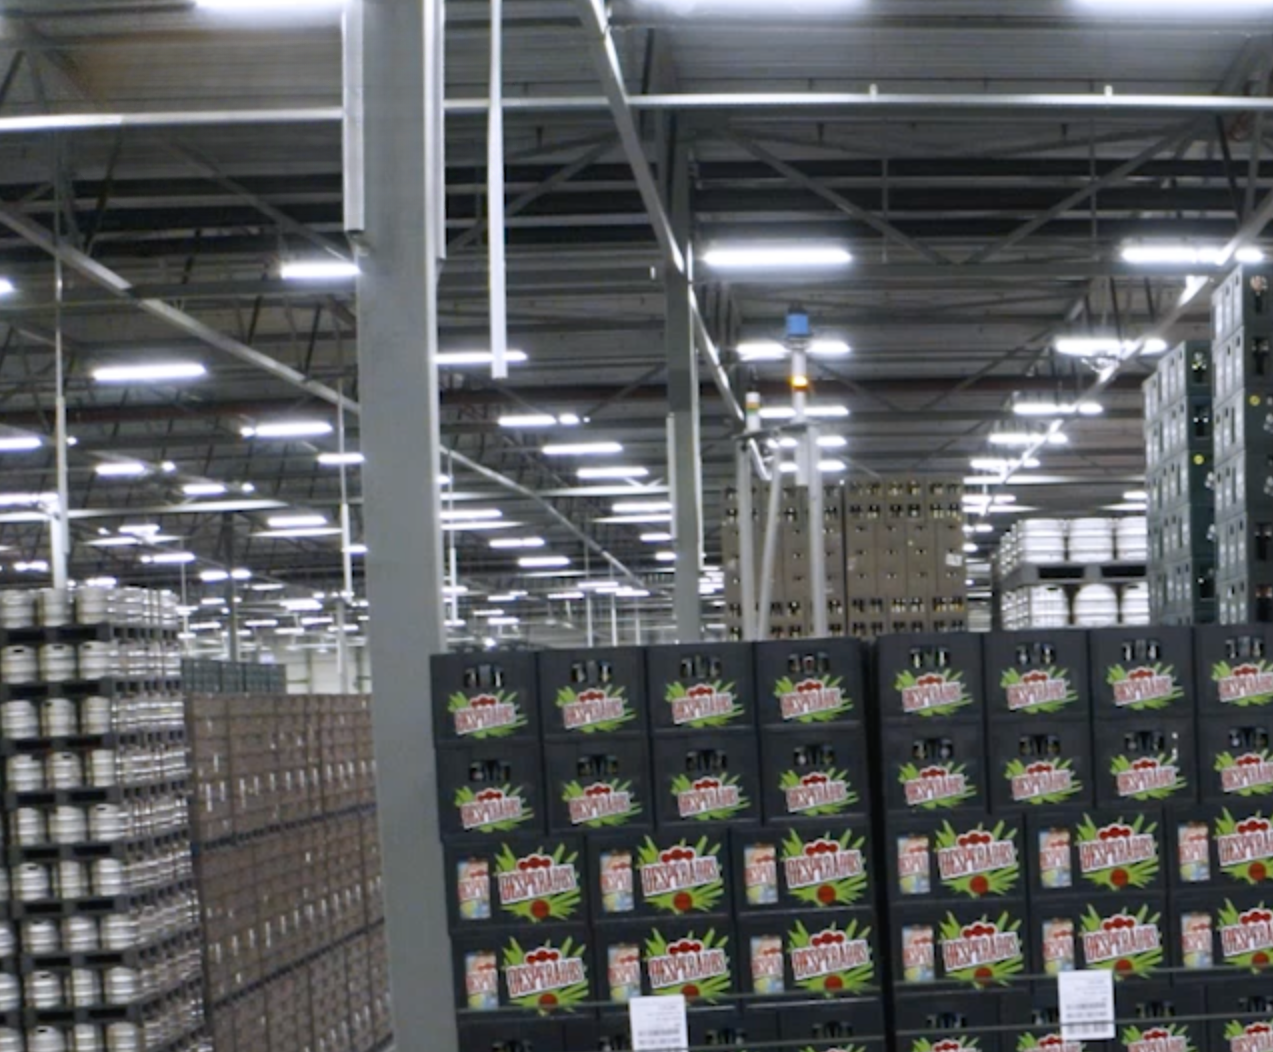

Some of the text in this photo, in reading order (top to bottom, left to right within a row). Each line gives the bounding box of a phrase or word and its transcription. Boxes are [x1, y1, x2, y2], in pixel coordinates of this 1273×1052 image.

[786, 851, 862, 888] DESPERADOS
[940, 843, 1013, 878] DESPERADOS
[1081, 836, 1154, 871] DESPERADOS
[500, 866, 576, 903] DESPERADOS
[642, 858, 718, 895] DESPERADOS
[794, 942, 867, 977] DESPERADOS
[945, 934, 1018, 969] DESPERADOS
[1085, 927, 1158, 962] DESPERADOS
[507, 959, 583, 996] DESPERADOS
[651, 951, 724, 986] DESPERADOS
